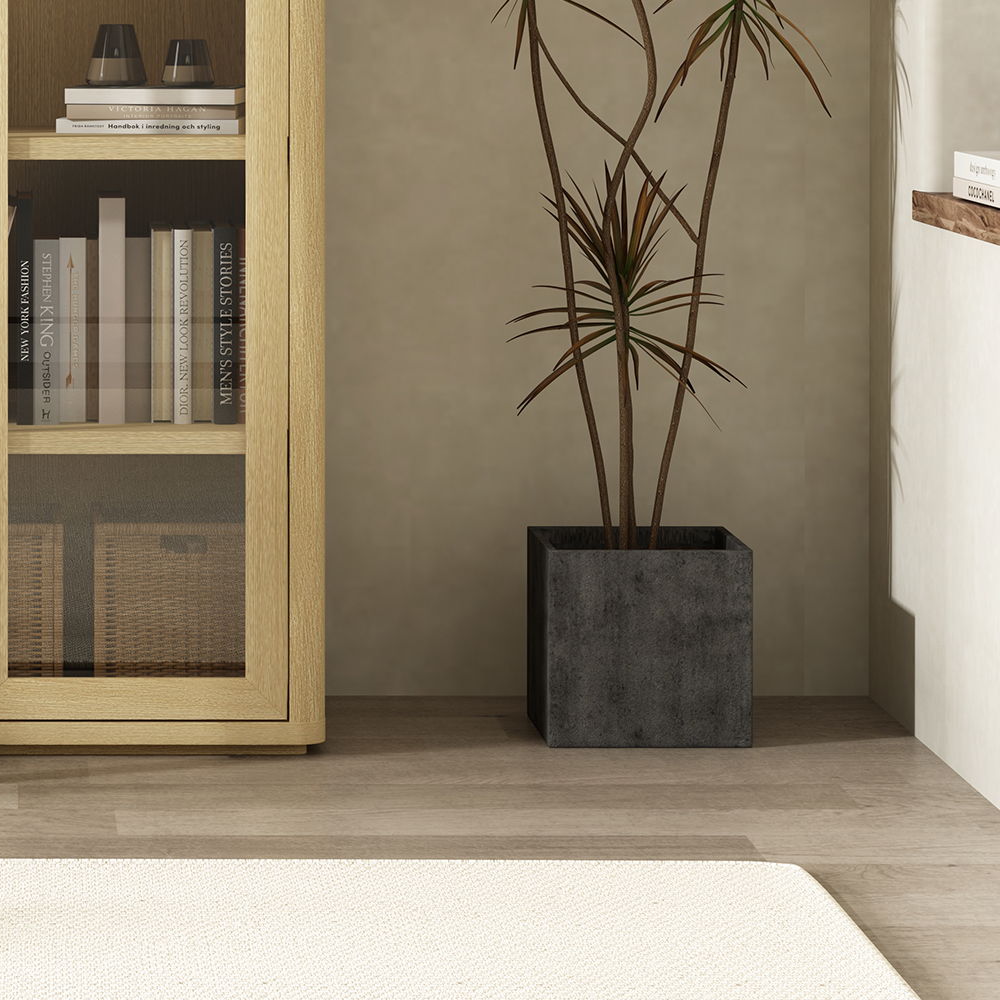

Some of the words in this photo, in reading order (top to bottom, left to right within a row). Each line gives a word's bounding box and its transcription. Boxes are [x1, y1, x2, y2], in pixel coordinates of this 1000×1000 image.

[145, 123, 180, 131] inredning
[196, 123, 221, 131] styling
[166, 105, 207, 113] HAGAN
[20, 260, 30, 304] FASHION
[41, 252, 52, 301] STEPHEN
[179, 239, 189, 315] REVOLUTION
[219, 241, 233, 308] STORIES
[20, 307, 30, 335] YORK
[39, 305, 55, 348] KING
[179, 316, 189, 353] LOOK
[219, 309, 233, 358] STYLE
[20, 338, 30, 362] NEW
[179, 354, 189, 382] NEW
[41, 351, 52, 404] OUTSIDER
[219, 358, 233, 406] MEN'S
